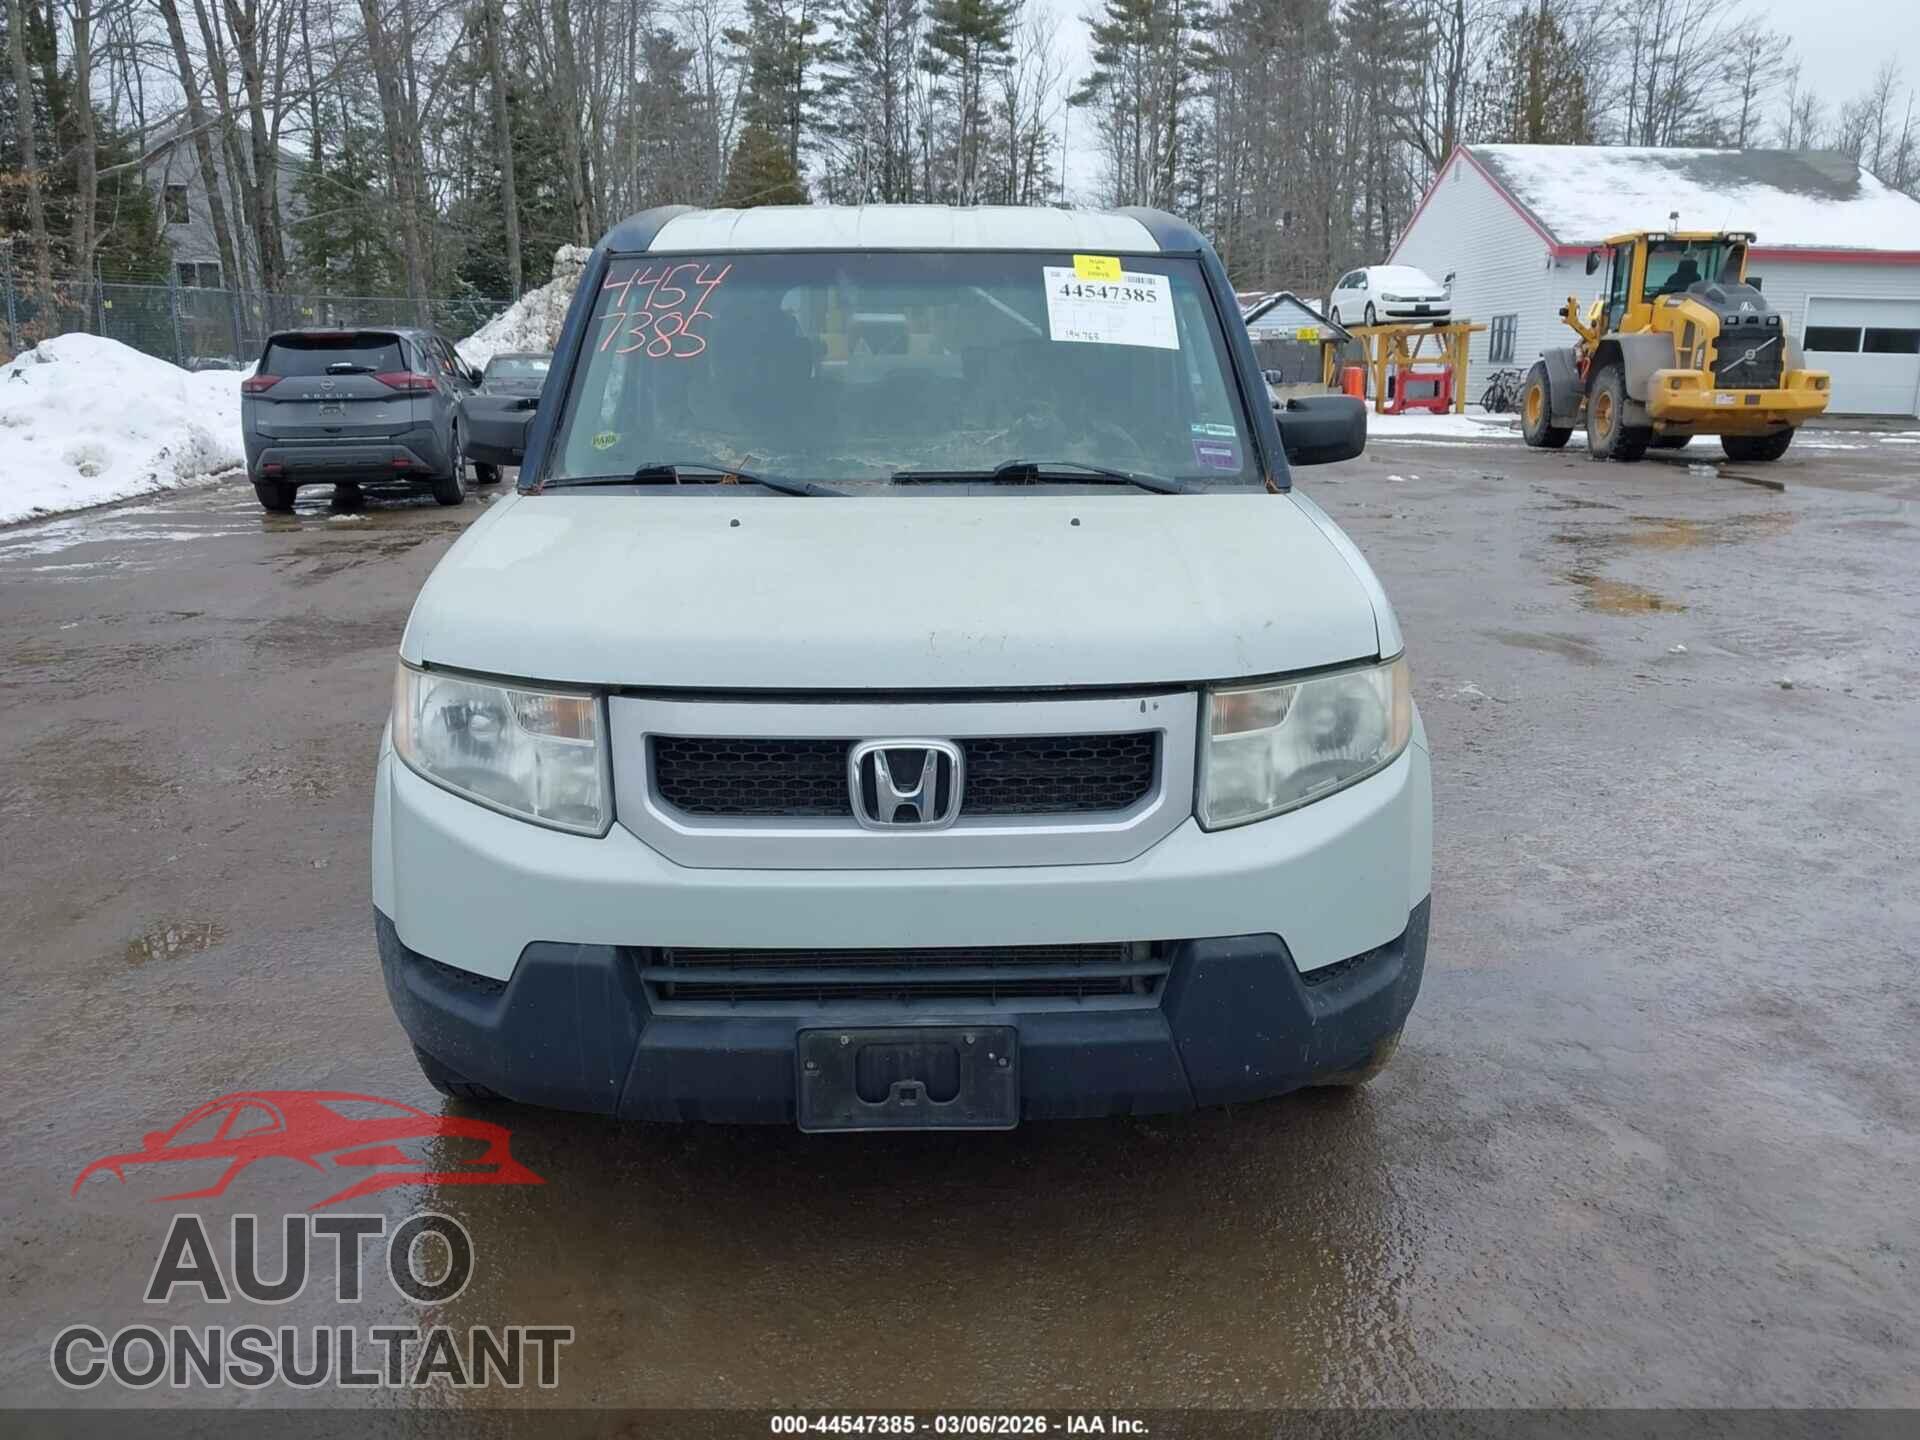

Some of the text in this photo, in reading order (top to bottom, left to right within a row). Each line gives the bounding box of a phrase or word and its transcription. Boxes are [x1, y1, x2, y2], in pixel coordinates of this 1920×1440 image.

[603, 263, 732, 309] 4454
[1059, 283, 1158, 303] 44547385
[599, 311, 713, 357] 7385
